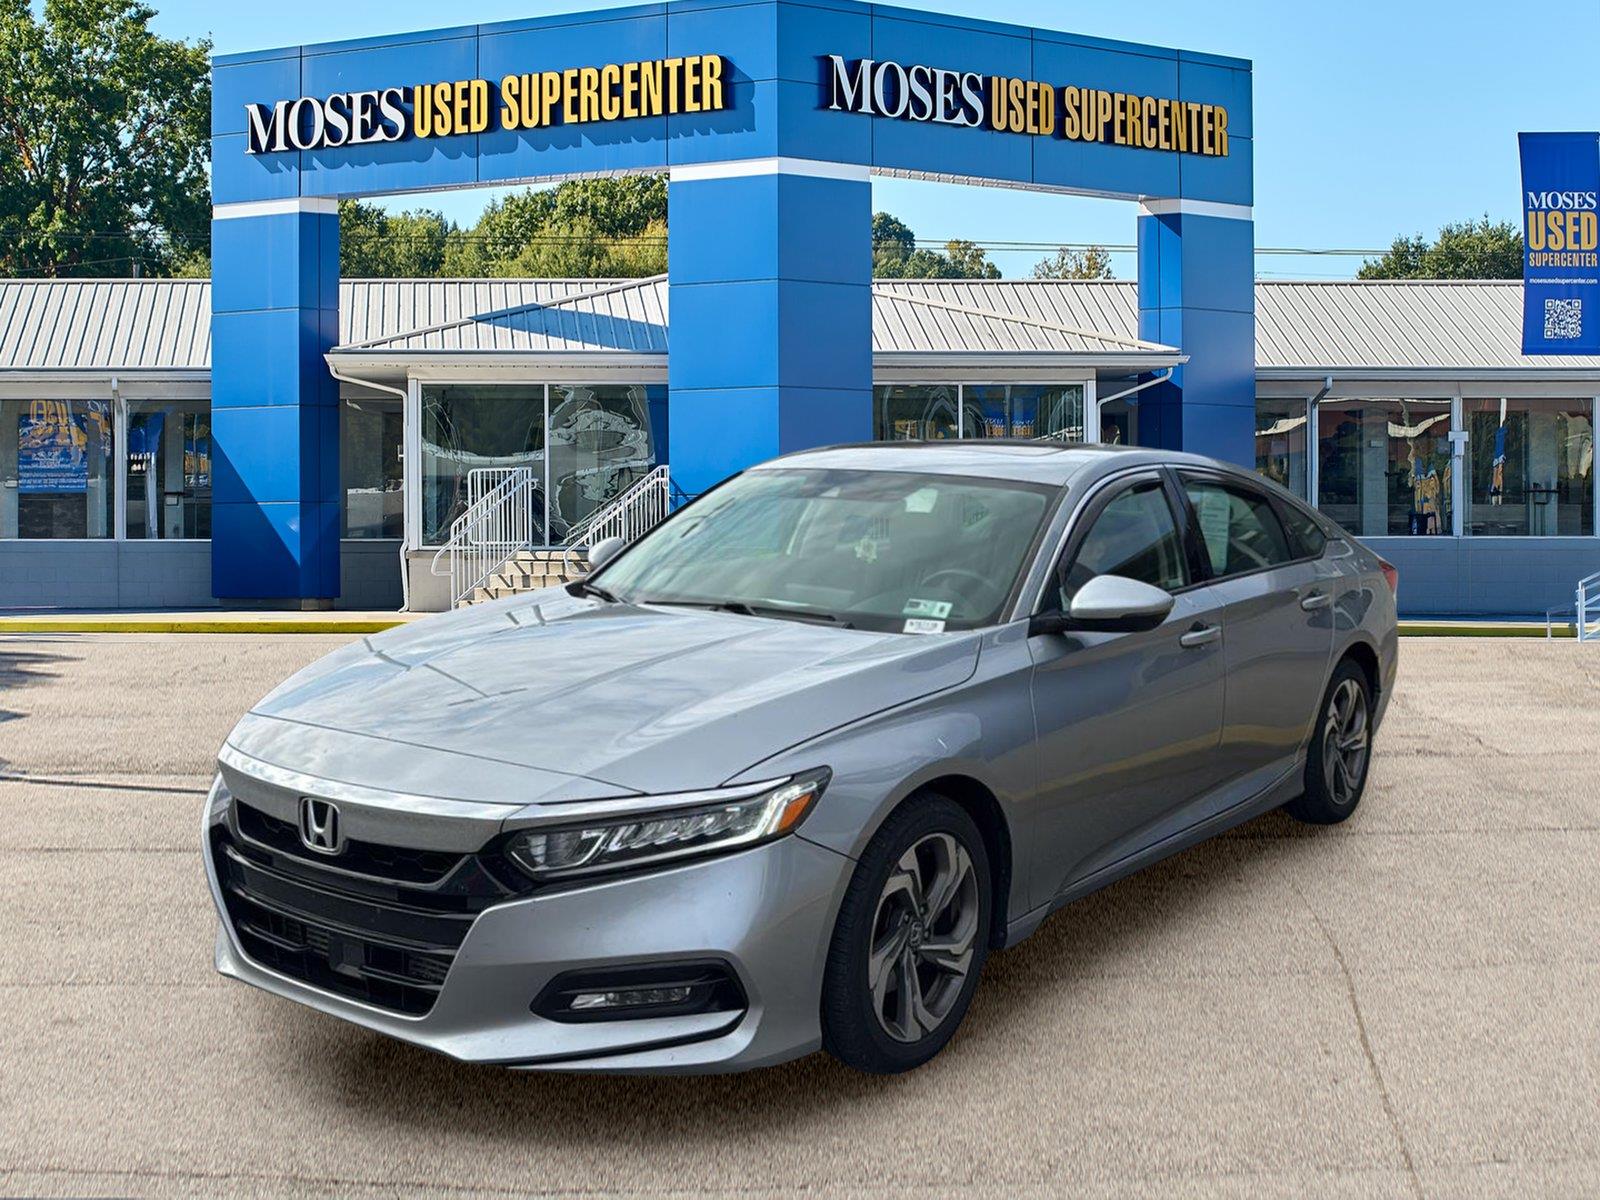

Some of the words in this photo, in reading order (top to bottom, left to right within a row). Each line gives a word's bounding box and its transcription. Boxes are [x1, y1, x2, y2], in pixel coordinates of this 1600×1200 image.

[244, 87, 406, 155] MOSES
[412, 79, 490, 139] USED
[500, 53, 724, 131] SUPERCENTER
[828, 54, 984, 128] MOSES
[991, 76, 1056, 136] USED
[1065, 86, 1230, 157] SUPERCENTER
[1527, 191, 1597, 209] MOSES
[1528, 211, 1598, 250] USED
[1529, 253, 1598, 267] SUPERCENTER
